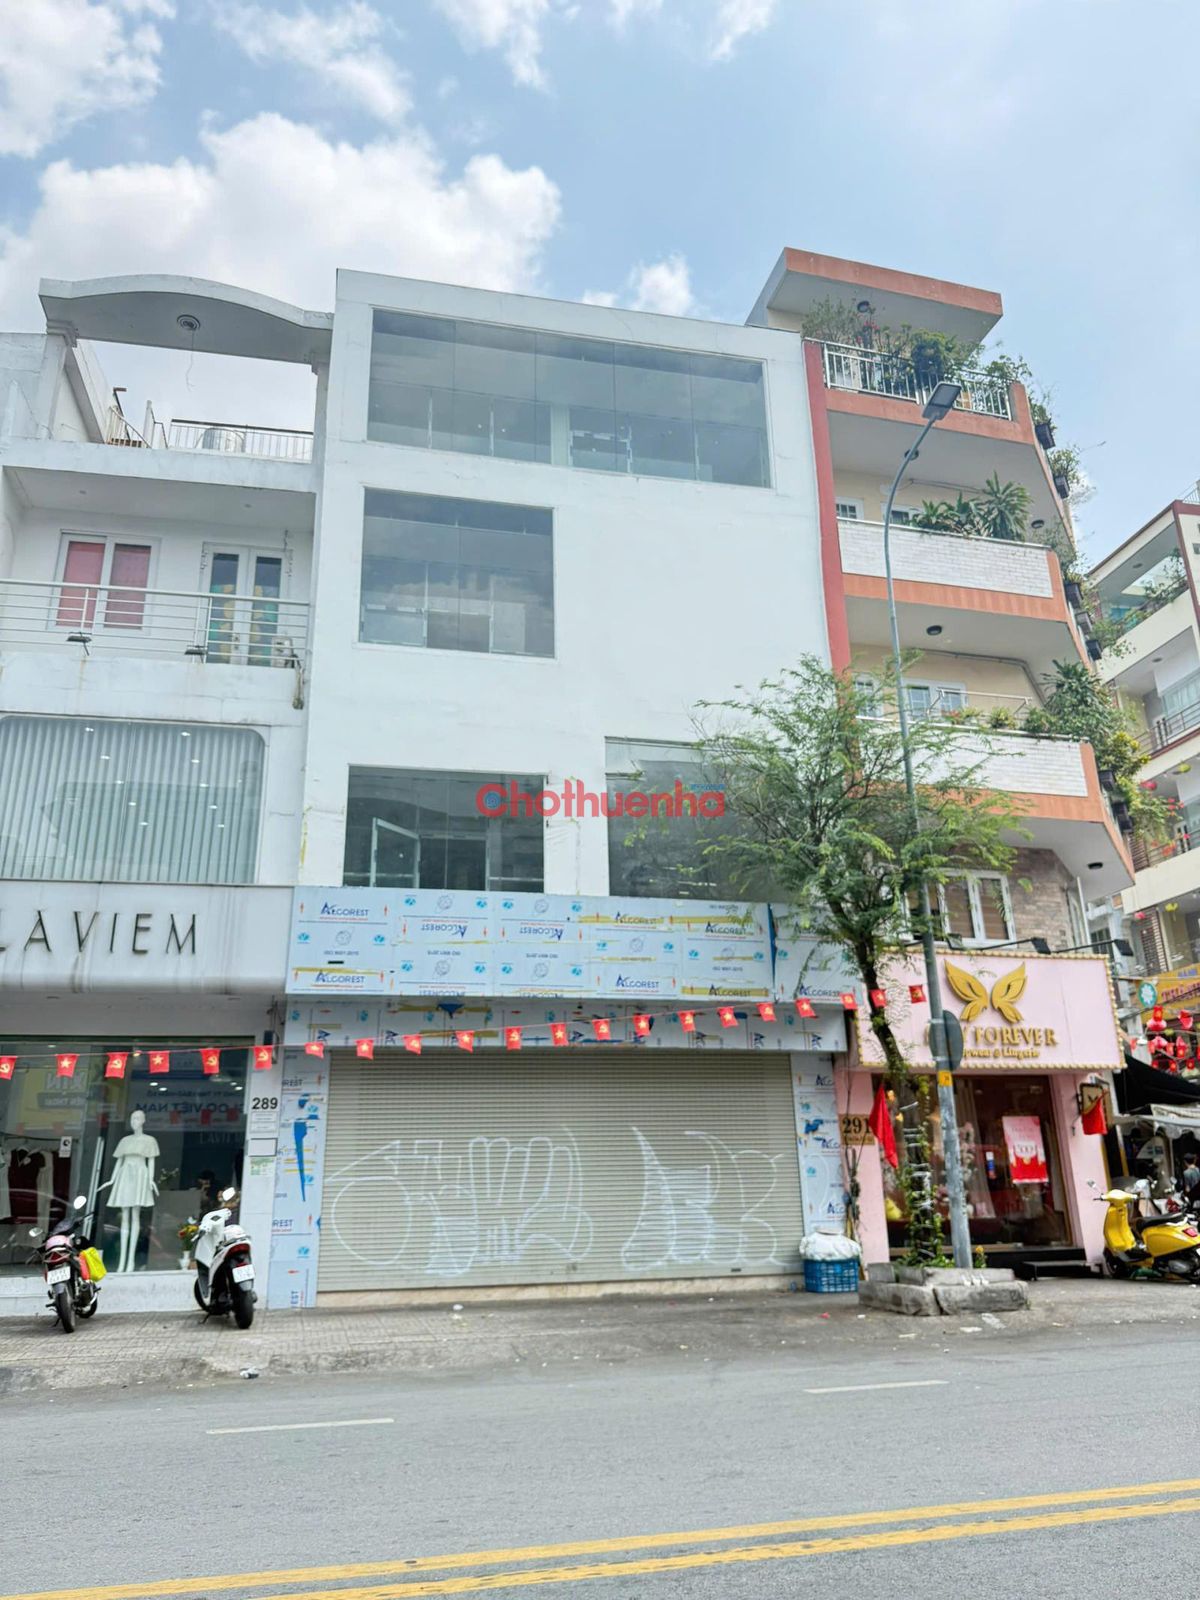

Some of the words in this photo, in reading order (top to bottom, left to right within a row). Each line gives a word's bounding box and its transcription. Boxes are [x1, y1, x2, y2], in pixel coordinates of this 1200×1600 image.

[0, 910, 197, 955] AVIEM
[974, 1025, 1058, 1047] FOREVER
[1002, 1046, 1040, 1060] Lingerie
[252, 1097, 279, 1110] 289
[842, 1117, 871, 1134] 291
